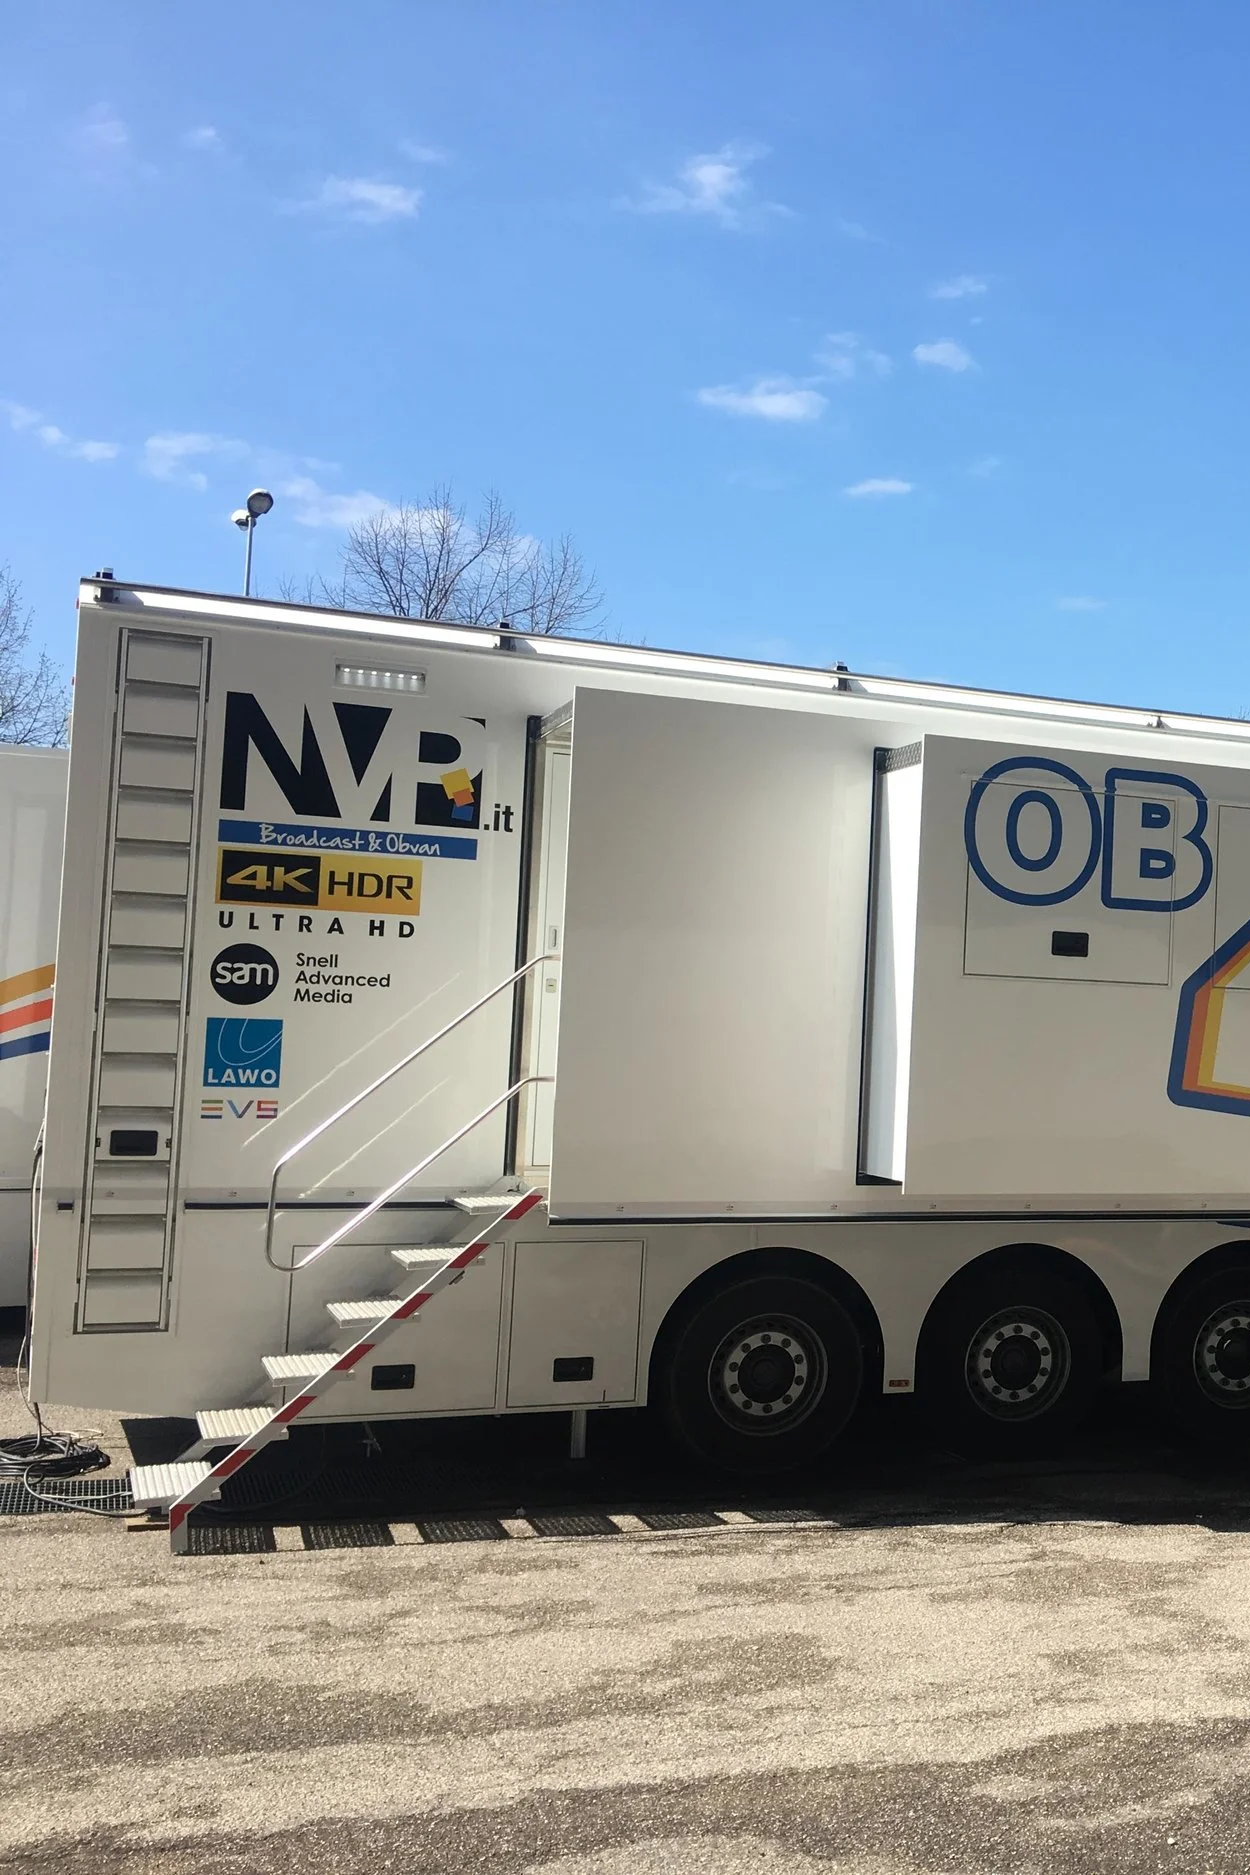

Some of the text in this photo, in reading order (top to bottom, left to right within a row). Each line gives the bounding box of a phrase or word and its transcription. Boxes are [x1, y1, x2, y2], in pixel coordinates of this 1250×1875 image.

[259, 823, 440, 856] Broadcast & Obvan
[963, 756, 1212, 912] OB
[226, 865, 414, 901] 4K HDR
[218, 911, 415, 938] ULTRA HD
[296, 953, 338, 968] Snell
[215, 961, 274, 986] sam
[295, 970, 391, 988] Advanced
[293, 988, 352, 1004] Media
[207, 1068, 277, 1085] LAWO
[200, 1100, 278, 1119] EVS
